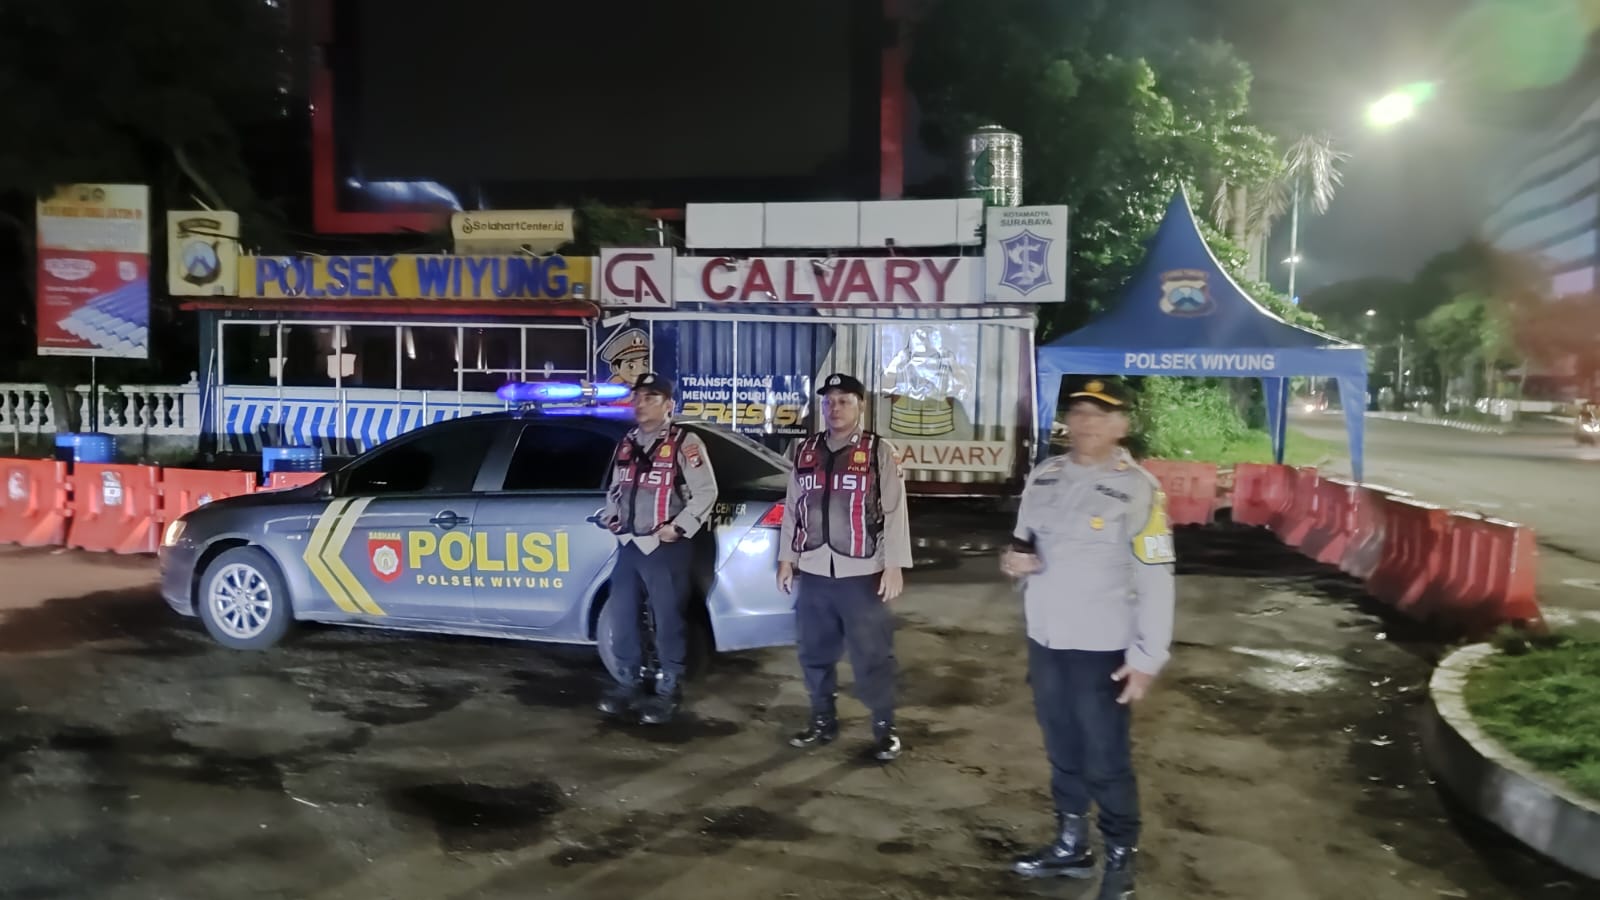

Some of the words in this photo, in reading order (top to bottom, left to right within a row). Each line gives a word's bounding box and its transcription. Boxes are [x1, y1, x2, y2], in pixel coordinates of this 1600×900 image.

[473, 220, 564, 232] SolahartCenter.id
[1000, 218, 1053, 227] SURABAYA
[256, 255, 398, 298] POLSEK
[416, 254, 570, 299] WIYUNG
[701, 256, 961, 303] CALVARY
[1124, 352, 1198, 371] POLSEK
[1201, 353, 1276, 372] WIYUNG
[682, 376, 773, 388] TRANSFORMASI
[682, 390, 730, 401] MENUJU
[408, 530, 570, 573] POLISI
[416, 573, 485, 588] POLSEK
[491, 575, 564, 589] WIYUNG
